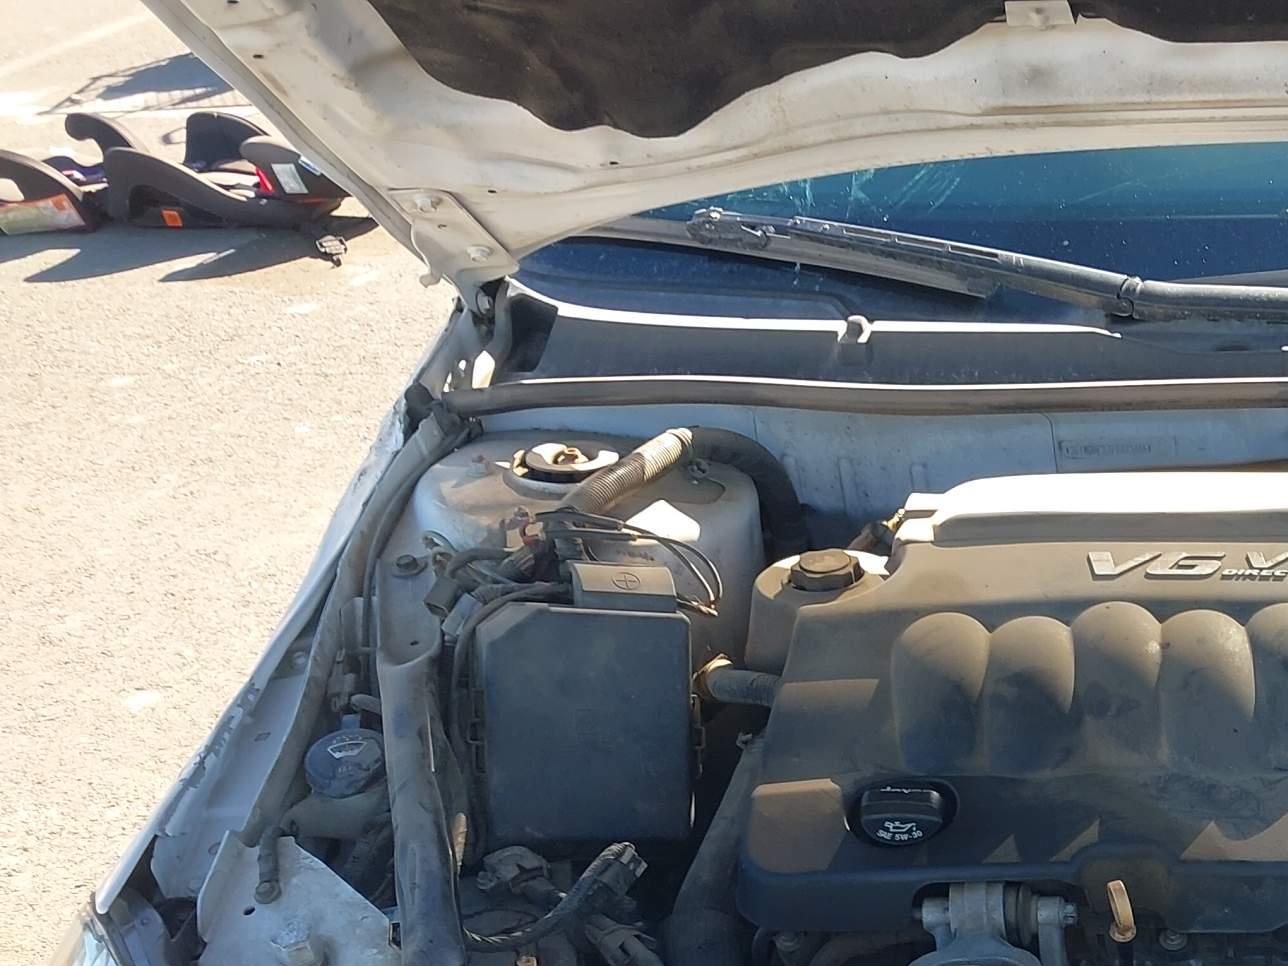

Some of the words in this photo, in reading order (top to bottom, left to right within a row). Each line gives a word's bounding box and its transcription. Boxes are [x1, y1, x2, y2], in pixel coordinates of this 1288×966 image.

[1087, 551, 1226, 581] V6
[876, 829, 892, 840] SAE
[894, 830, 923, 841] 5W-30
